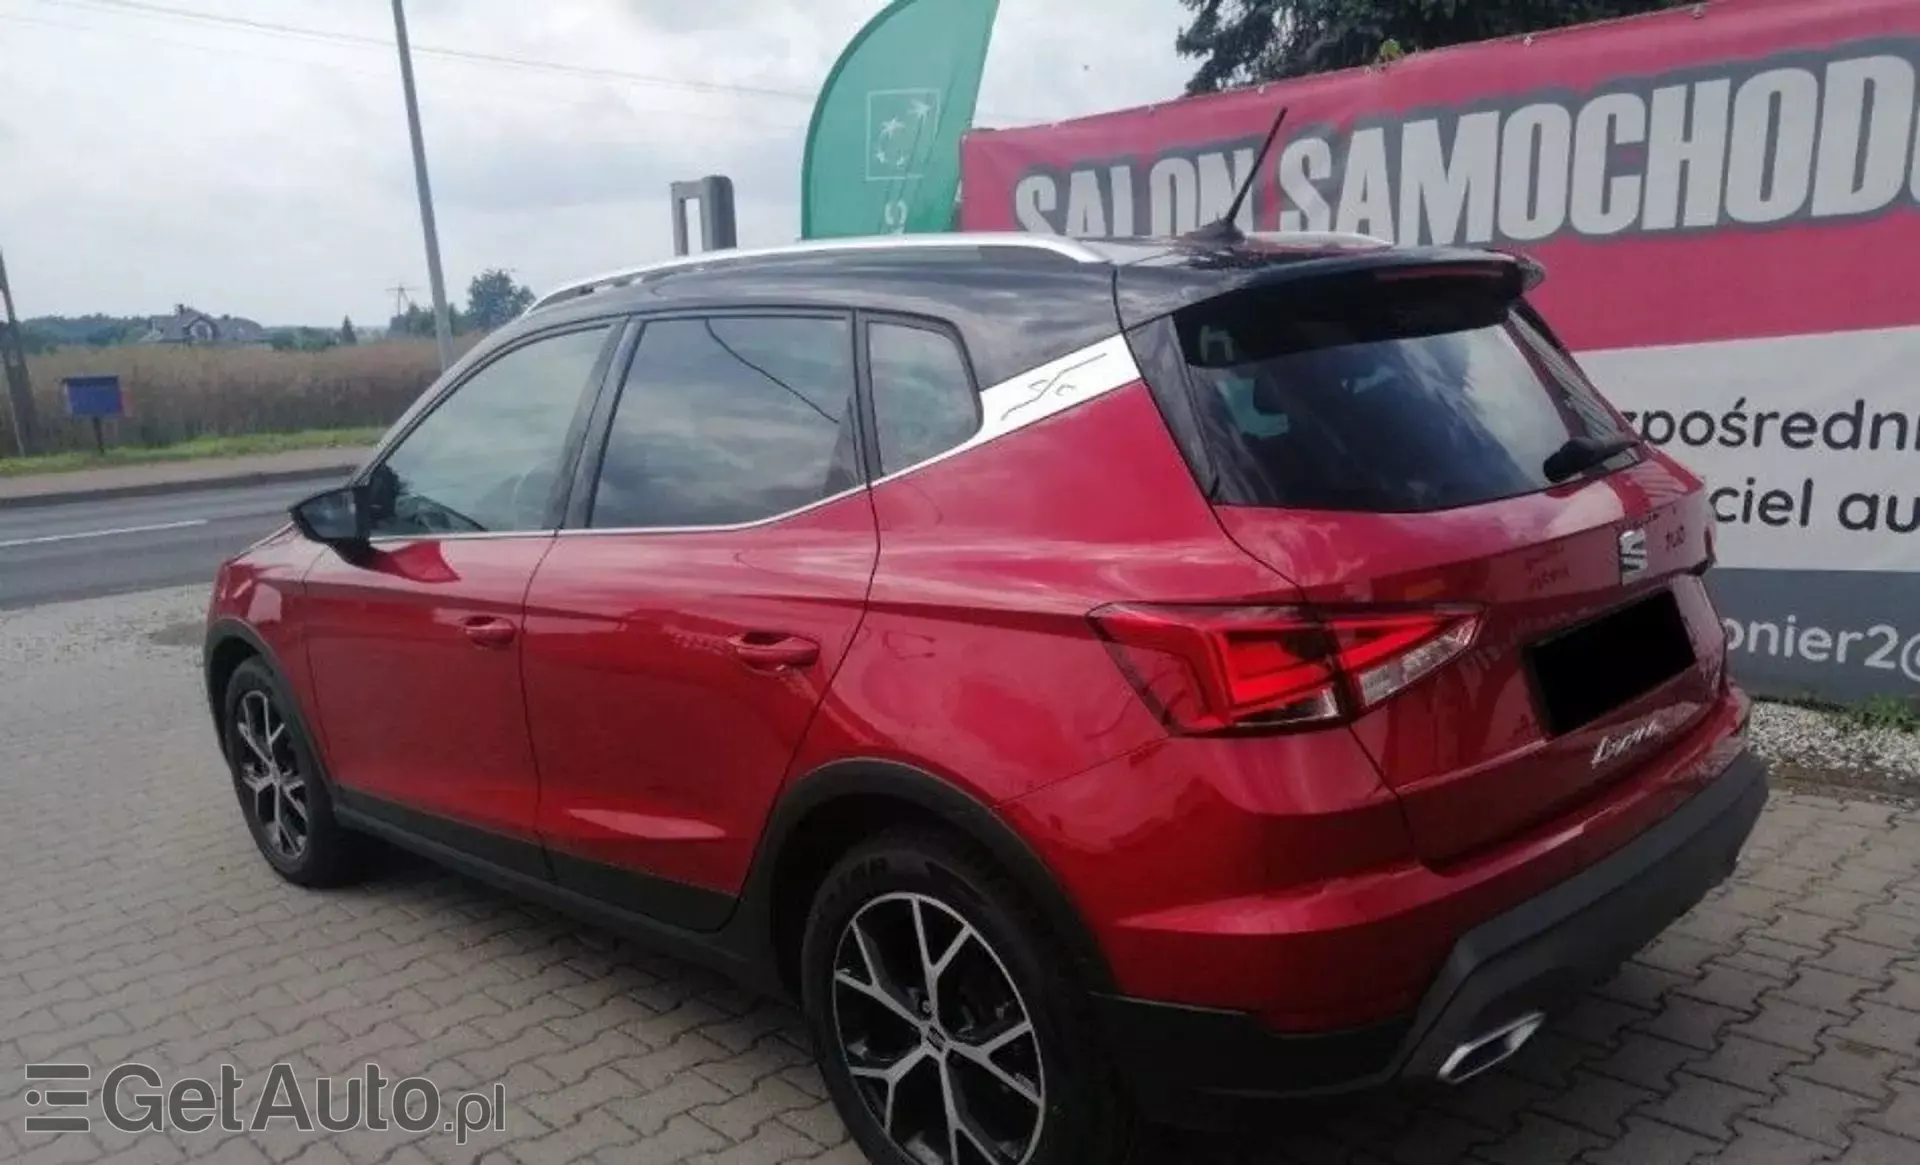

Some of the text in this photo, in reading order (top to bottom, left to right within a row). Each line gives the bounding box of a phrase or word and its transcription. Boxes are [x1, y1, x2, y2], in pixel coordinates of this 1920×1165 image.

[1016, 55, 1920, 247] SALON SAMOCHOD
[1621, 397, 1920, 451] pośredn
[1708, 477, 1814, 528] ciel
